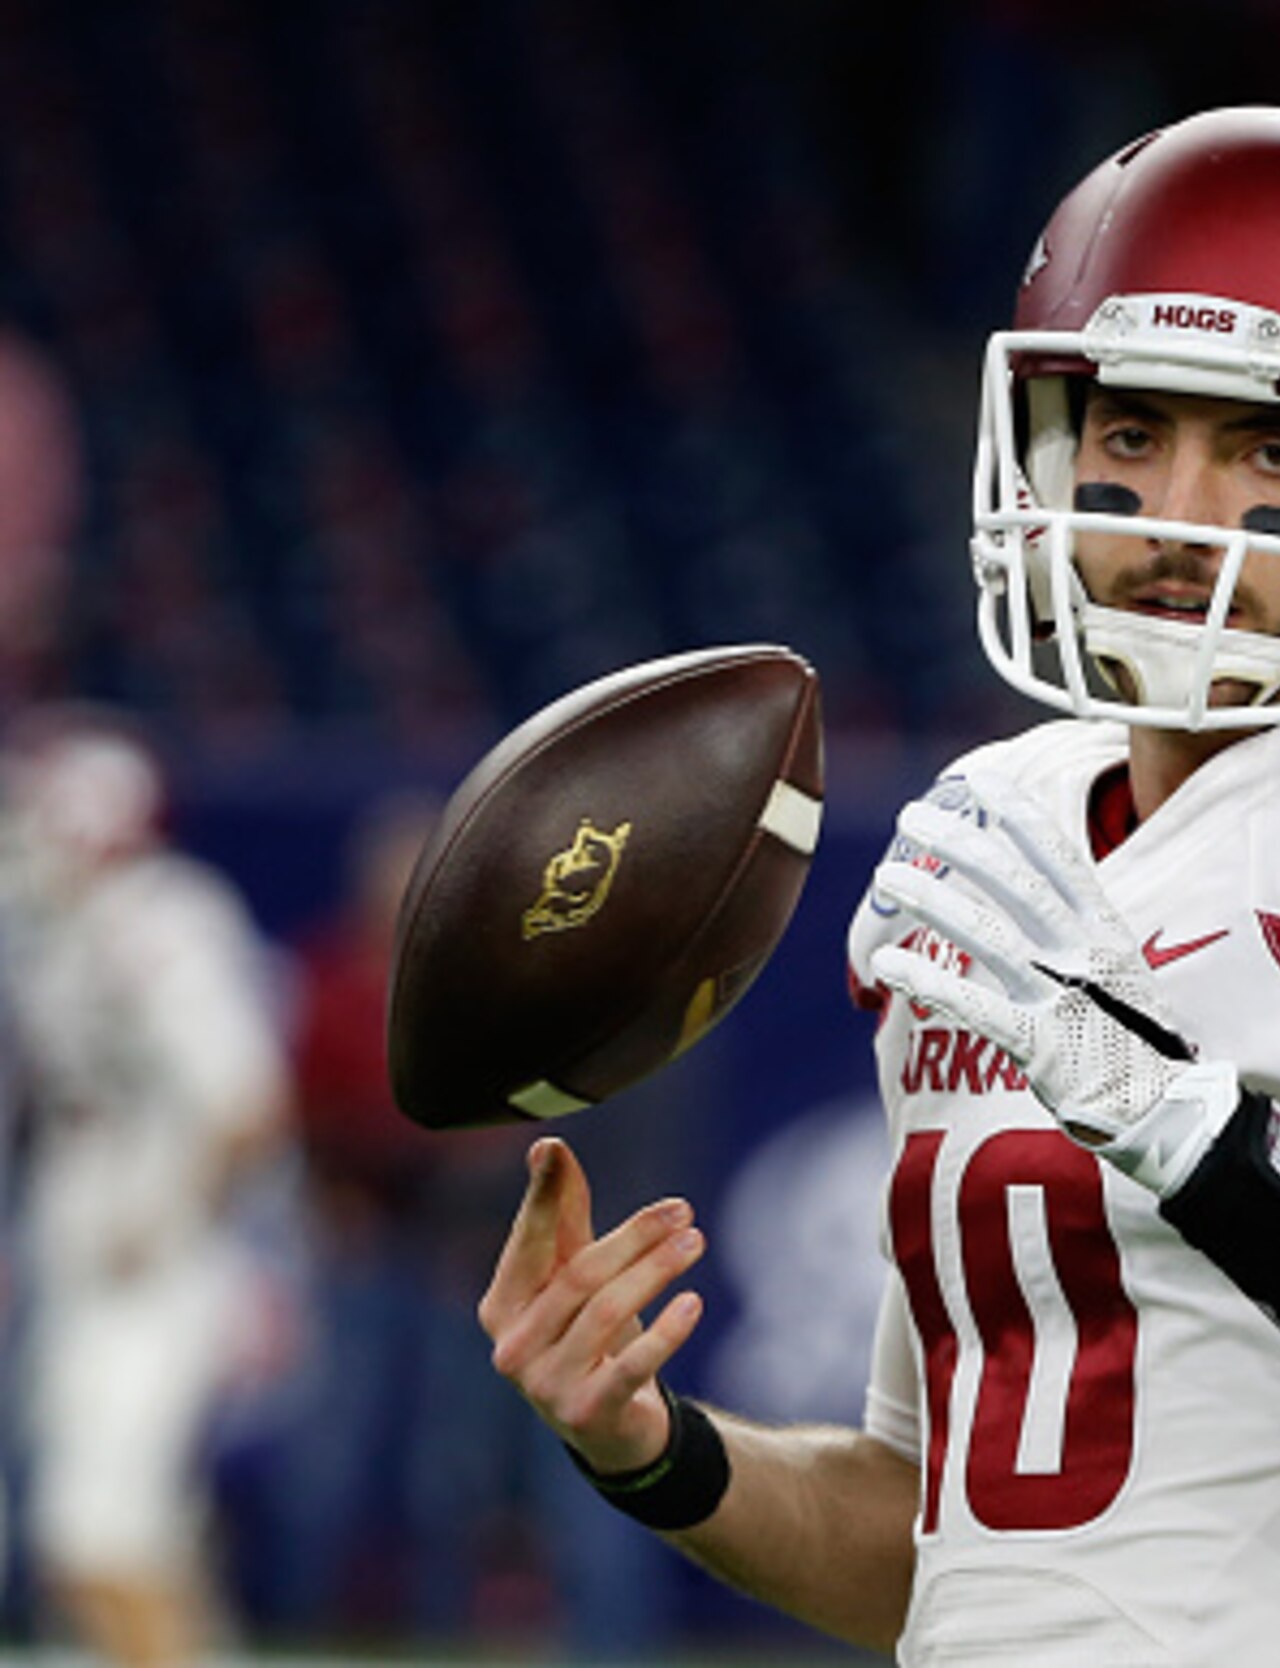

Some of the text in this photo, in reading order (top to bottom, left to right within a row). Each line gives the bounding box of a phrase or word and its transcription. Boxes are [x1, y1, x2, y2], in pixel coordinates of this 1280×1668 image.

[1152, 304, 1238, 333] HOGS
[902, 1028, 1029, 1095] RKA
[889, 1128, 1139, 1535] 10
